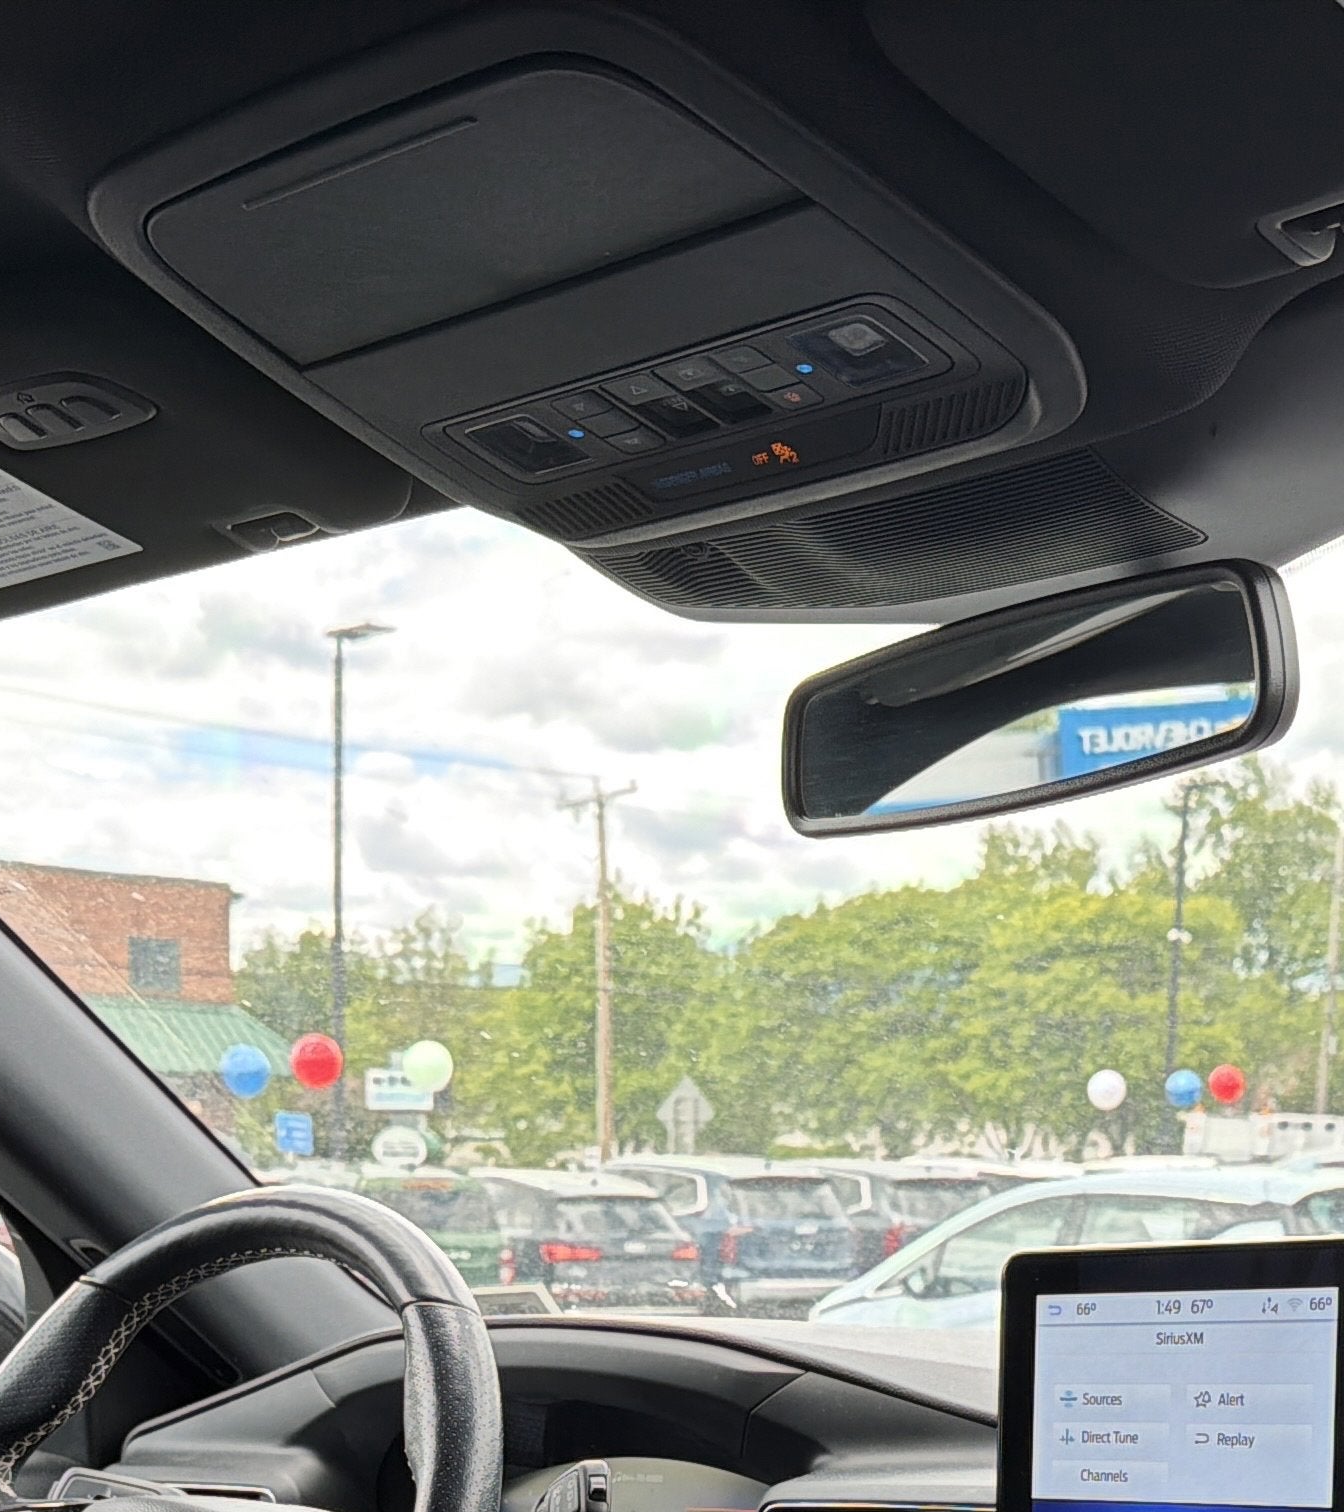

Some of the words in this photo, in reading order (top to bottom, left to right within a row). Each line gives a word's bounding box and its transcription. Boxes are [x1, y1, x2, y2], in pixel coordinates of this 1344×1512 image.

[751, 452, 769, 466] OFF
[1156, 1299, 1181, 1315] 1:49
[1155, 1331, 1204, 1346] SiriusXM
[1082, 1393, 1122, 1406] Sources
[1218, 1393, 1244, 1406] Alert
[1081, 1430, 1111, 1444] Direct
[1112, 1431, 1138, 1444] Tune
[1217, 1433, 1255, 1449] Replay
[1080, 1469, 1128, 1483] Channels
